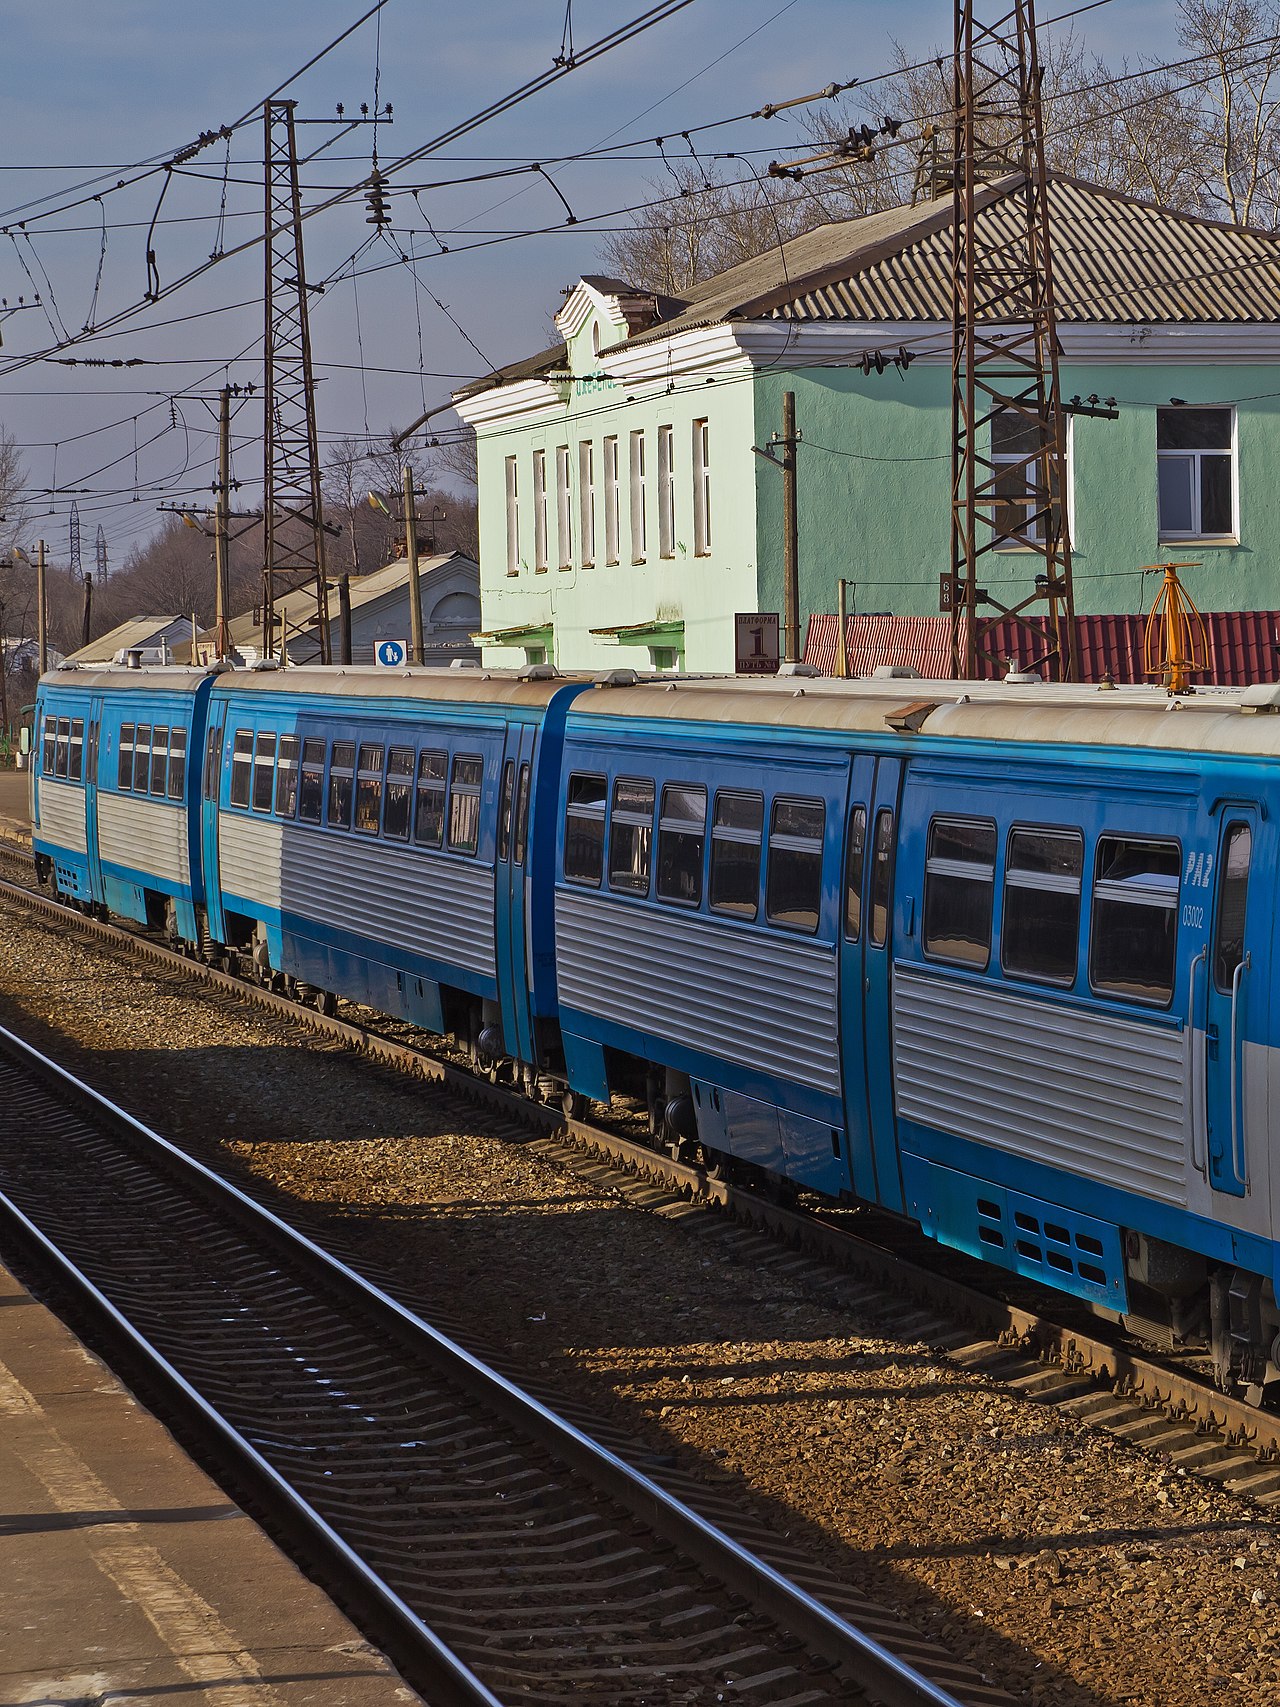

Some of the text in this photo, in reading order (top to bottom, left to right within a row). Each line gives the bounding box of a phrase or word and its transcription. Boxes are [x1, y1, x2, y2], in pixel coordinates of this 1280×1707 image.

[738, 616, 776, 624] ПЛАТФОРМА
[749, 627, 768, 658] 1
[1182, 904, 1204, 928] 03002
